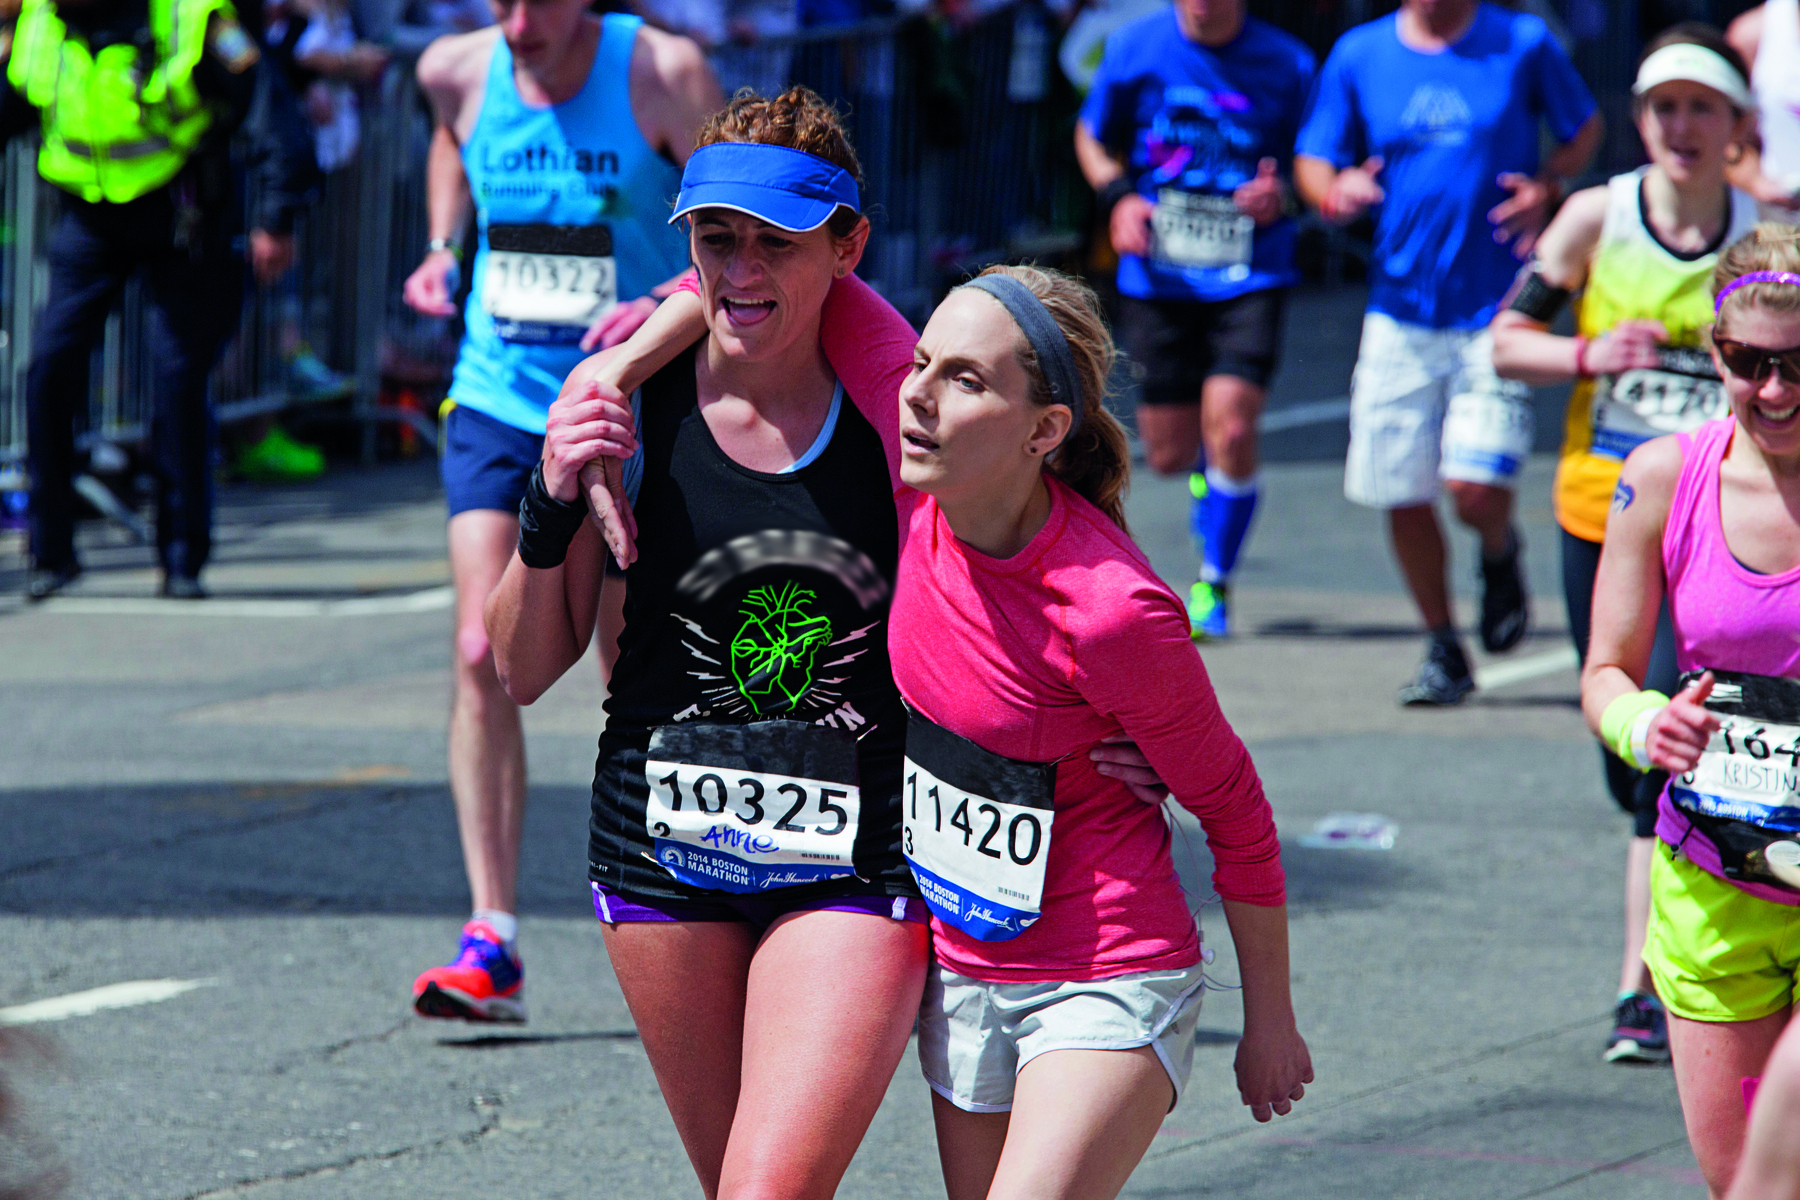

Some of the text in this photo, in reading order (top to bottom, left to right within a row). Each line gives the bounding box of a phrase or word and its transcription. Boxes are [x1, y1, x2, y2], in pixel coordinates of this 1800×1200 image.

[483, 142, 619, 174] Lothian
[498, 253, 608, 295] 10322
[1723, 759, 1798, 791] KRISTIN
[659, 769, 848, 836] 10325
[653, 821, 671, 837] 2
[907, 771, 1042, 866] 11420
[699, 825, 780, 854] Anne
[904, 826, 914, 856] 3
[687, 851, 749, 876] 2014 BOSTON
[687, 861, 749, 886] MARATHON
[919, 874, 960, 904] 2014 BOSTON
[919, 884, 960, 915] MARATHON
